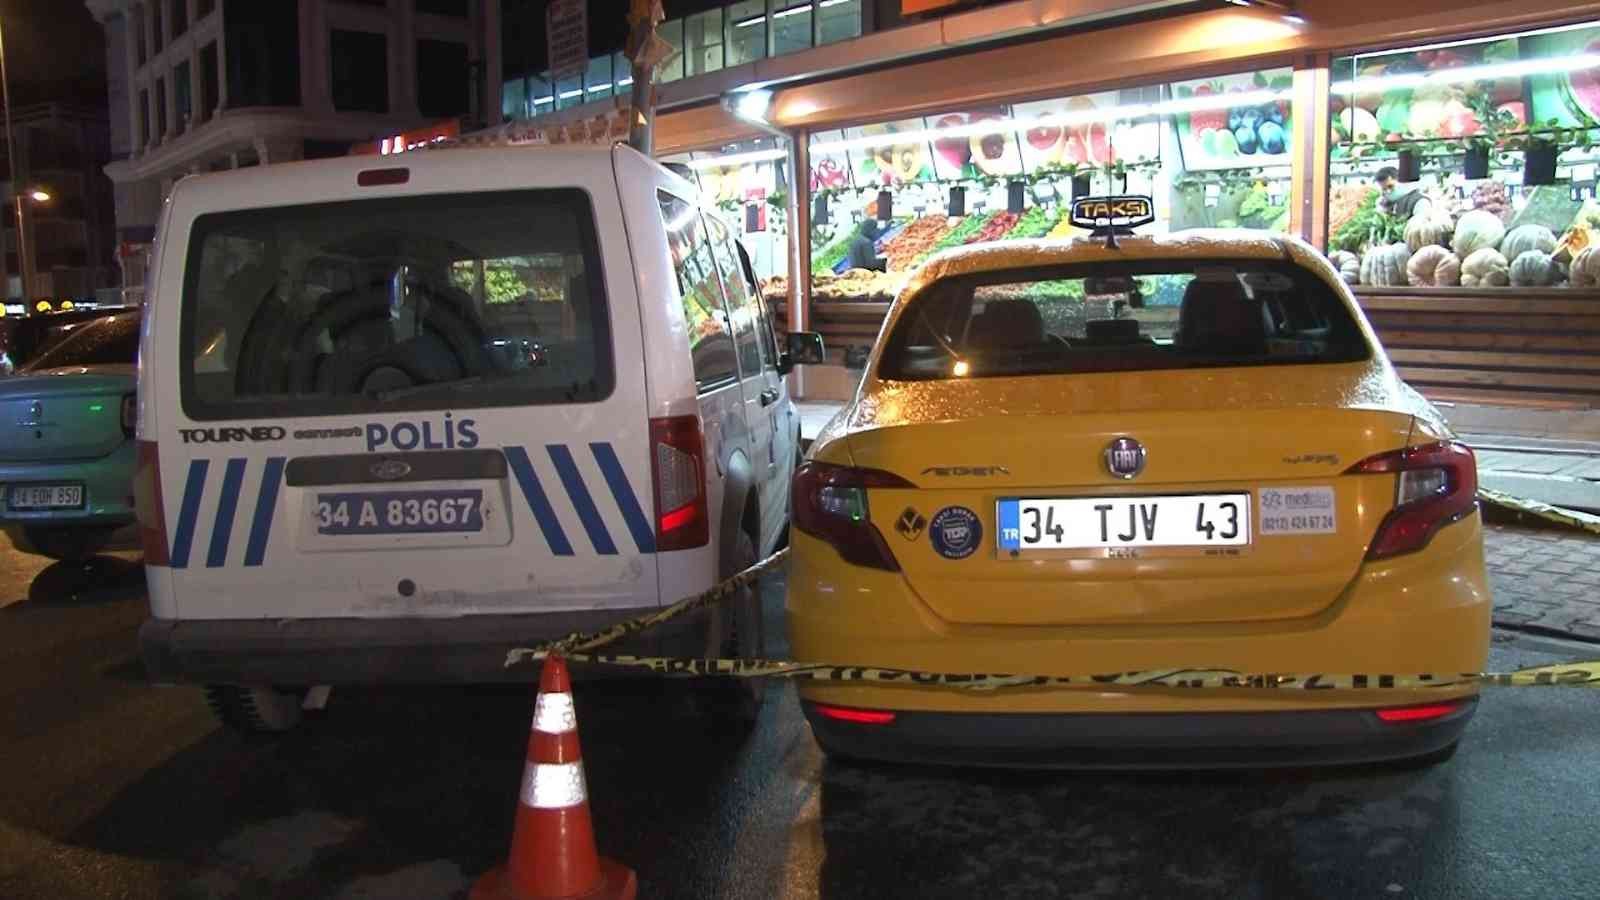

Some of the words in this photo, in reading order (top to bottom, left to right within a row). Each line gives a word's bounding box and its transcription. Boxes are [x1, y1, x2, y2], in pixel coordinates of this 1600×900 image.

[366, 411, 479, 453] POLİS
[1113, 450, 1138, 469] FIAT
[319, 501, 350, 528] 34
[358, 500, 379, 526] A
[386, 497, 474, 526] 83667
[1003, 528, 1019, 541] TR
[1022, 505, 1065, 545] 34
[1094, 502, 1158, 543] TJV
[1195, 501, 1239, 541] 43
